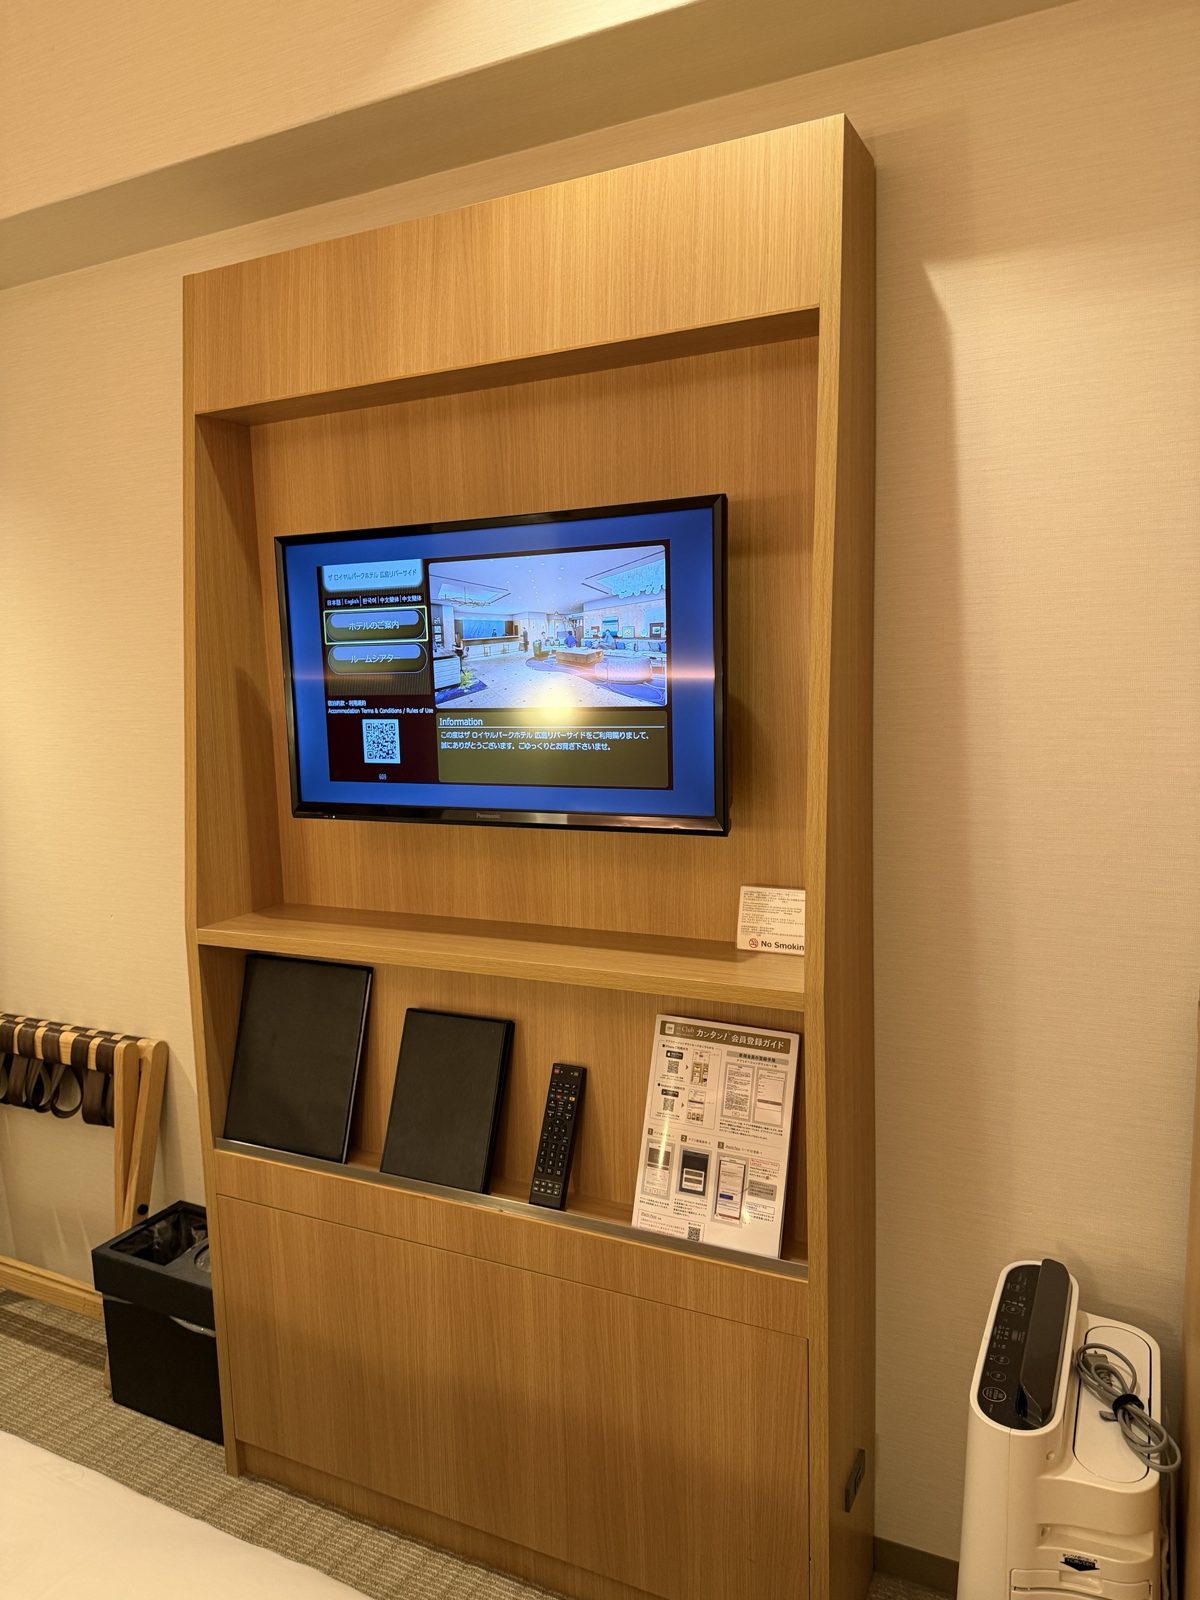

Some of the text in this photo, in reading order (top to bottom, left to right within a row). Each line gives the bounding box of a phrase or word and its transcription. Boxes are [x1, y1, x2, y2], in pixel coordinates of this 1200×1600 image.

[348, 620, 400, 631] ホテルのご案内
[351, 654, 401, 664] ルームシアター
[439, 718, 483, 726] Information
[471, 731, 533, 739] ロイヤルパークホテル
[761, 940, 805, 951] No Smokin
[731, 1034, 785, 1049] 会員登録ガイド
